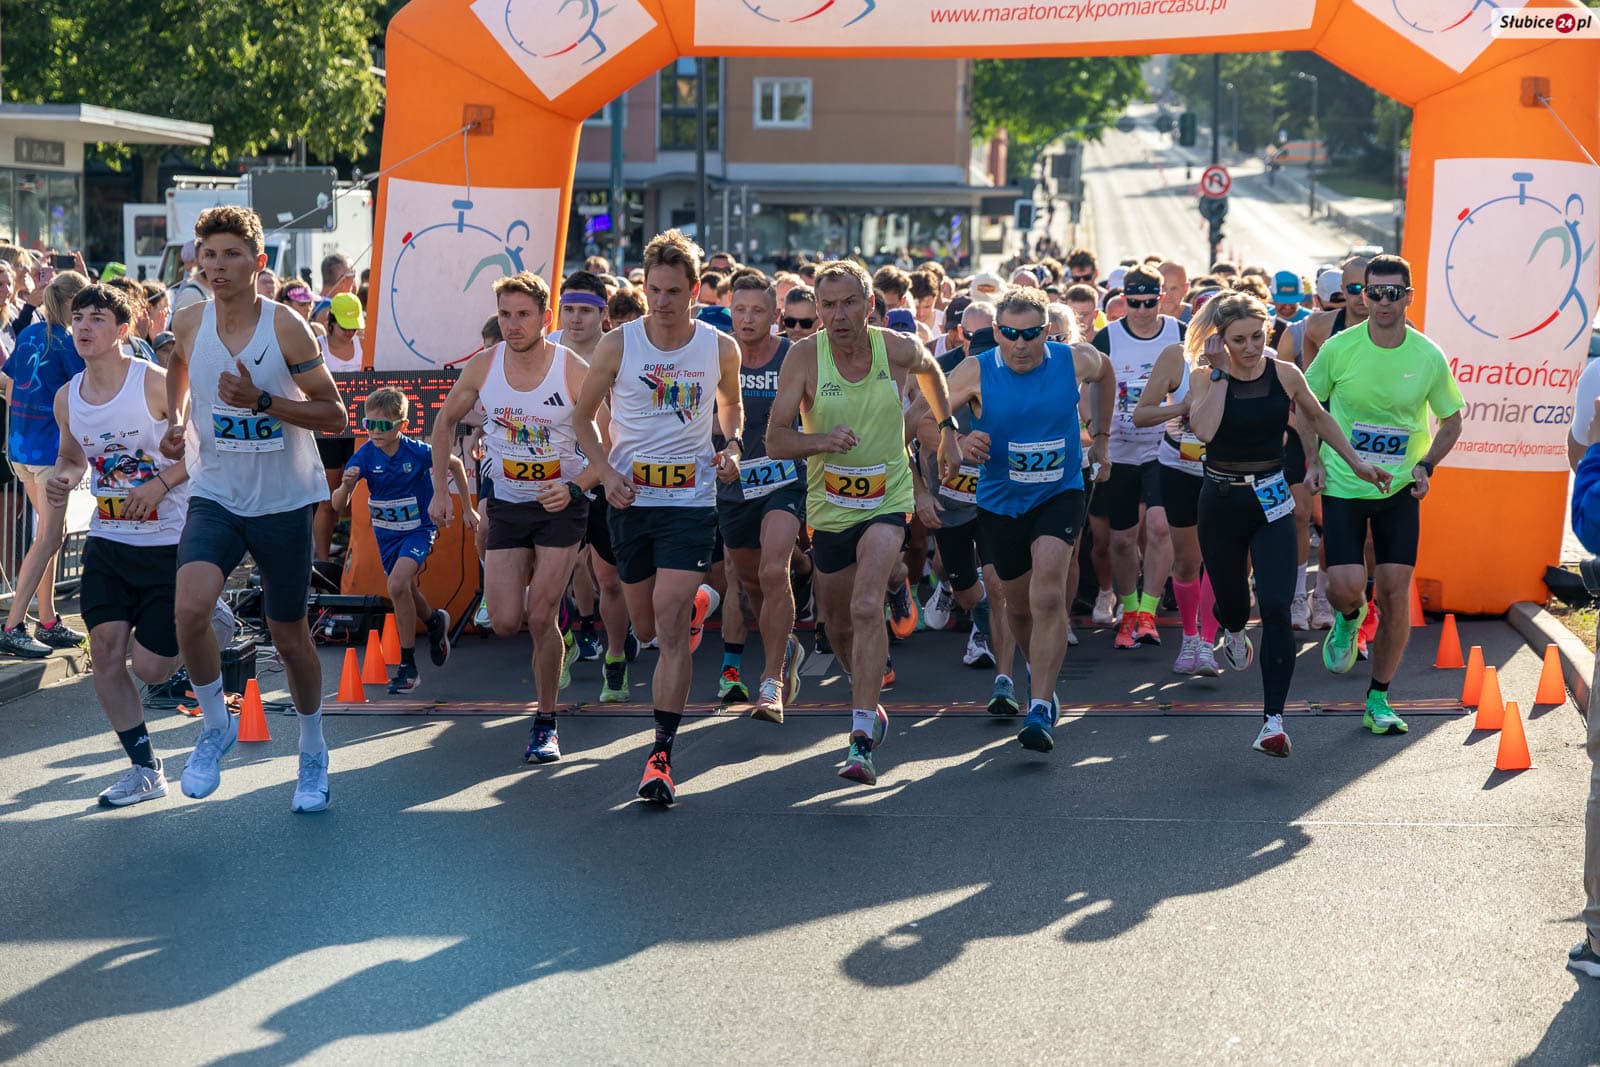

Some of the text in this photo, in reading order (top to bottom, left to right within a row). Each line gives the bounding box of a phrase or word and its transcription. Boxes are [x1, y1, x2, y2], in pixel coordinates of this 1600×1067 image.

[740, 371, 779, 390] ossFi
[220, 417, 272, 440] 216
[1355, 432, 1401, 454] 269
[515, 462, 546, 480] 28
[1015, 451, 1058, 472] 322
[641, 464, 687, 487] 115
[746, 462, 787, 486] 421
[838, 476, 870, 497] 29
[374, 506, 411, 522] 231
